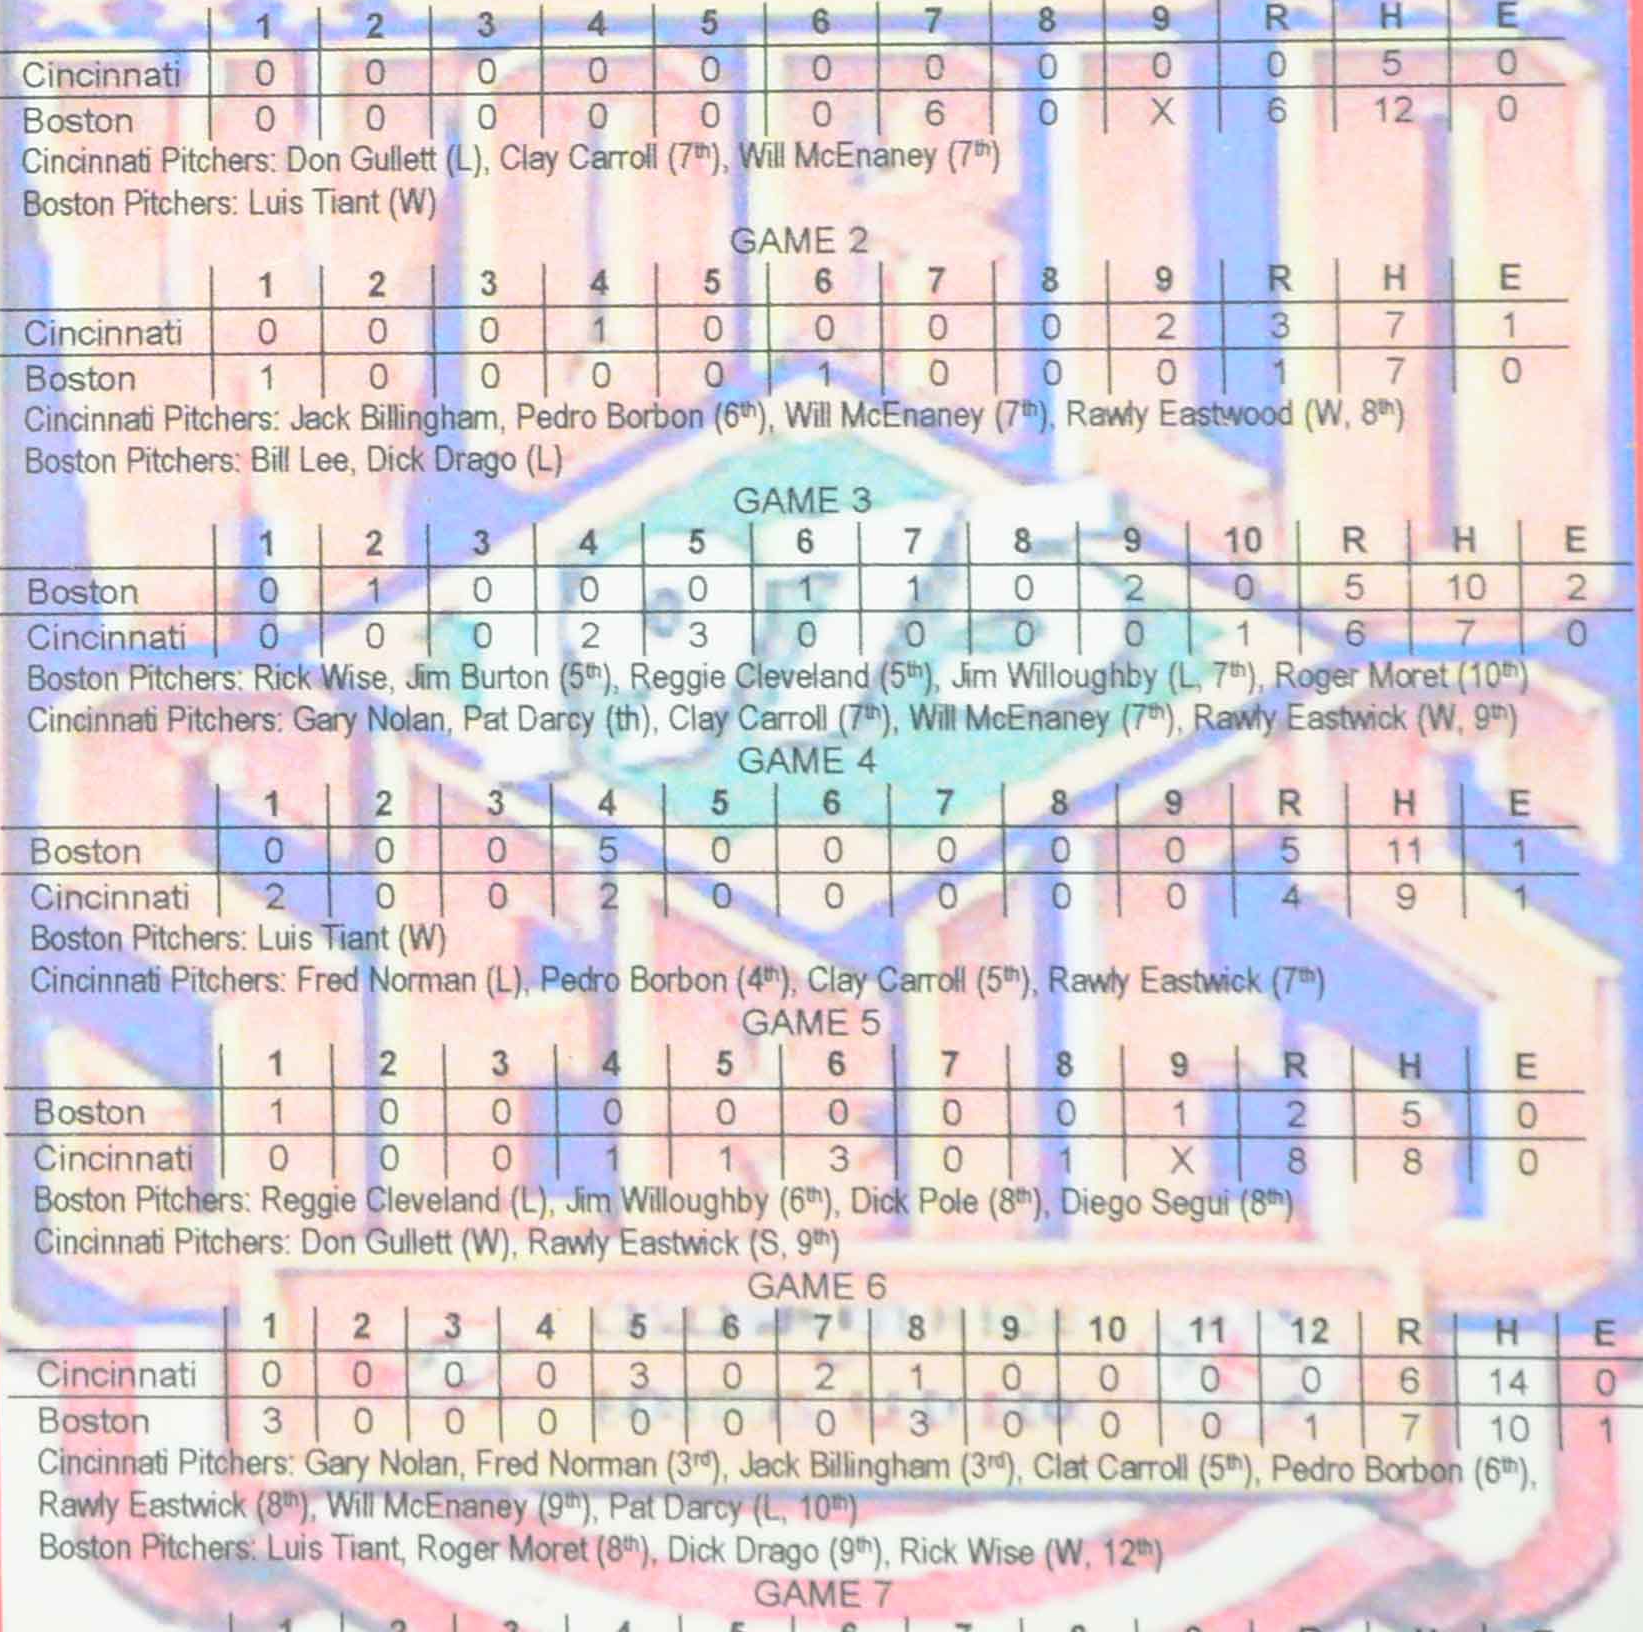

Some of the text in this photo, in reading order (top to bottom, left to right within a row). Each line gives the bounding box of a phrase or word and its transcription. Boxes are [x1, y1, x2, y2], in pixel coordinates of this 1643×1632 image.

[22, 60, 181, 89] Cincinnati
[23, 106, 133, 134] Boston
[21, 147, 151, 174] Cincinnati
[162, 146, 276, 173] Pitchers:
[287, 145, 341, 173] Don
[350, 144, 437, 172] Gullett
[446, 143, 489, 179] (L),
[500, 143, 559, 178] Clay
[568, 143, 657, 171] Carroll
[738, 141, 785, 171] Will
[794, 140, 937, 175] McEnaney
[23, 187, 436, 222] Boston Pitchers: Luis Tiant (W)
[730, 224, 869, 256] GAME 2
[24, 319, 182, 347] Cincinnati
[26, 364, 136, 393] Boston
[733, 485, 873, 515] GAME 3
[28, 577, 139, 605] Boston
[27, 623, 186, 651] Cincinnati
[738, 745, 877, 775] GAME 4
[30, 837, 140, 866] Boston
[31, 883, 189, 911] Cincinnati
[742, 1007, 882, 1037] GAME 5
[34, 1098, 145, 1126] Boston
[34, 1143, 193, 1172] Cincinnati
[34, 1227, 164, 1255] Cincinnati
[174, 1227, 287, 1255] Pitchers:
[301, 1227, 356, 1255] Don
[365, 1226, 452, 1255] Gullett
[461, 1227, 517, 1262] (W),
[529, 1227, 610, 1263] Rawly
[619, 1227, 739, 1257] Eastwick
[750, 1228, 786, 1262] (S,
[748, 1271, 887, 1301] GAME 6
[37, 1359, 196, 1388] Cincinnati
[38, 1406, 149, 1434] Boston
[39, 1532, 131, 1561] Boston
[142, 1532, 256, 1561] Pitchers:
[268, 1533, 323, 1561] Luis
[330, 1533, 406, 1565] Tiant,
[418, 1533, 500, 1569] Roger
[508, 1533, 588, 1562] Moret
[669, 1535, 726, 1563] Dick
[736, 1535, 819, 1571] Drago
[900, 1536, 957, 1565] Rick
[967, 1537, 1035, 1566] Wise
[1045, 1538, 1090, 1571] (W,
[754, 1579, 893, 1608] GAME 7
